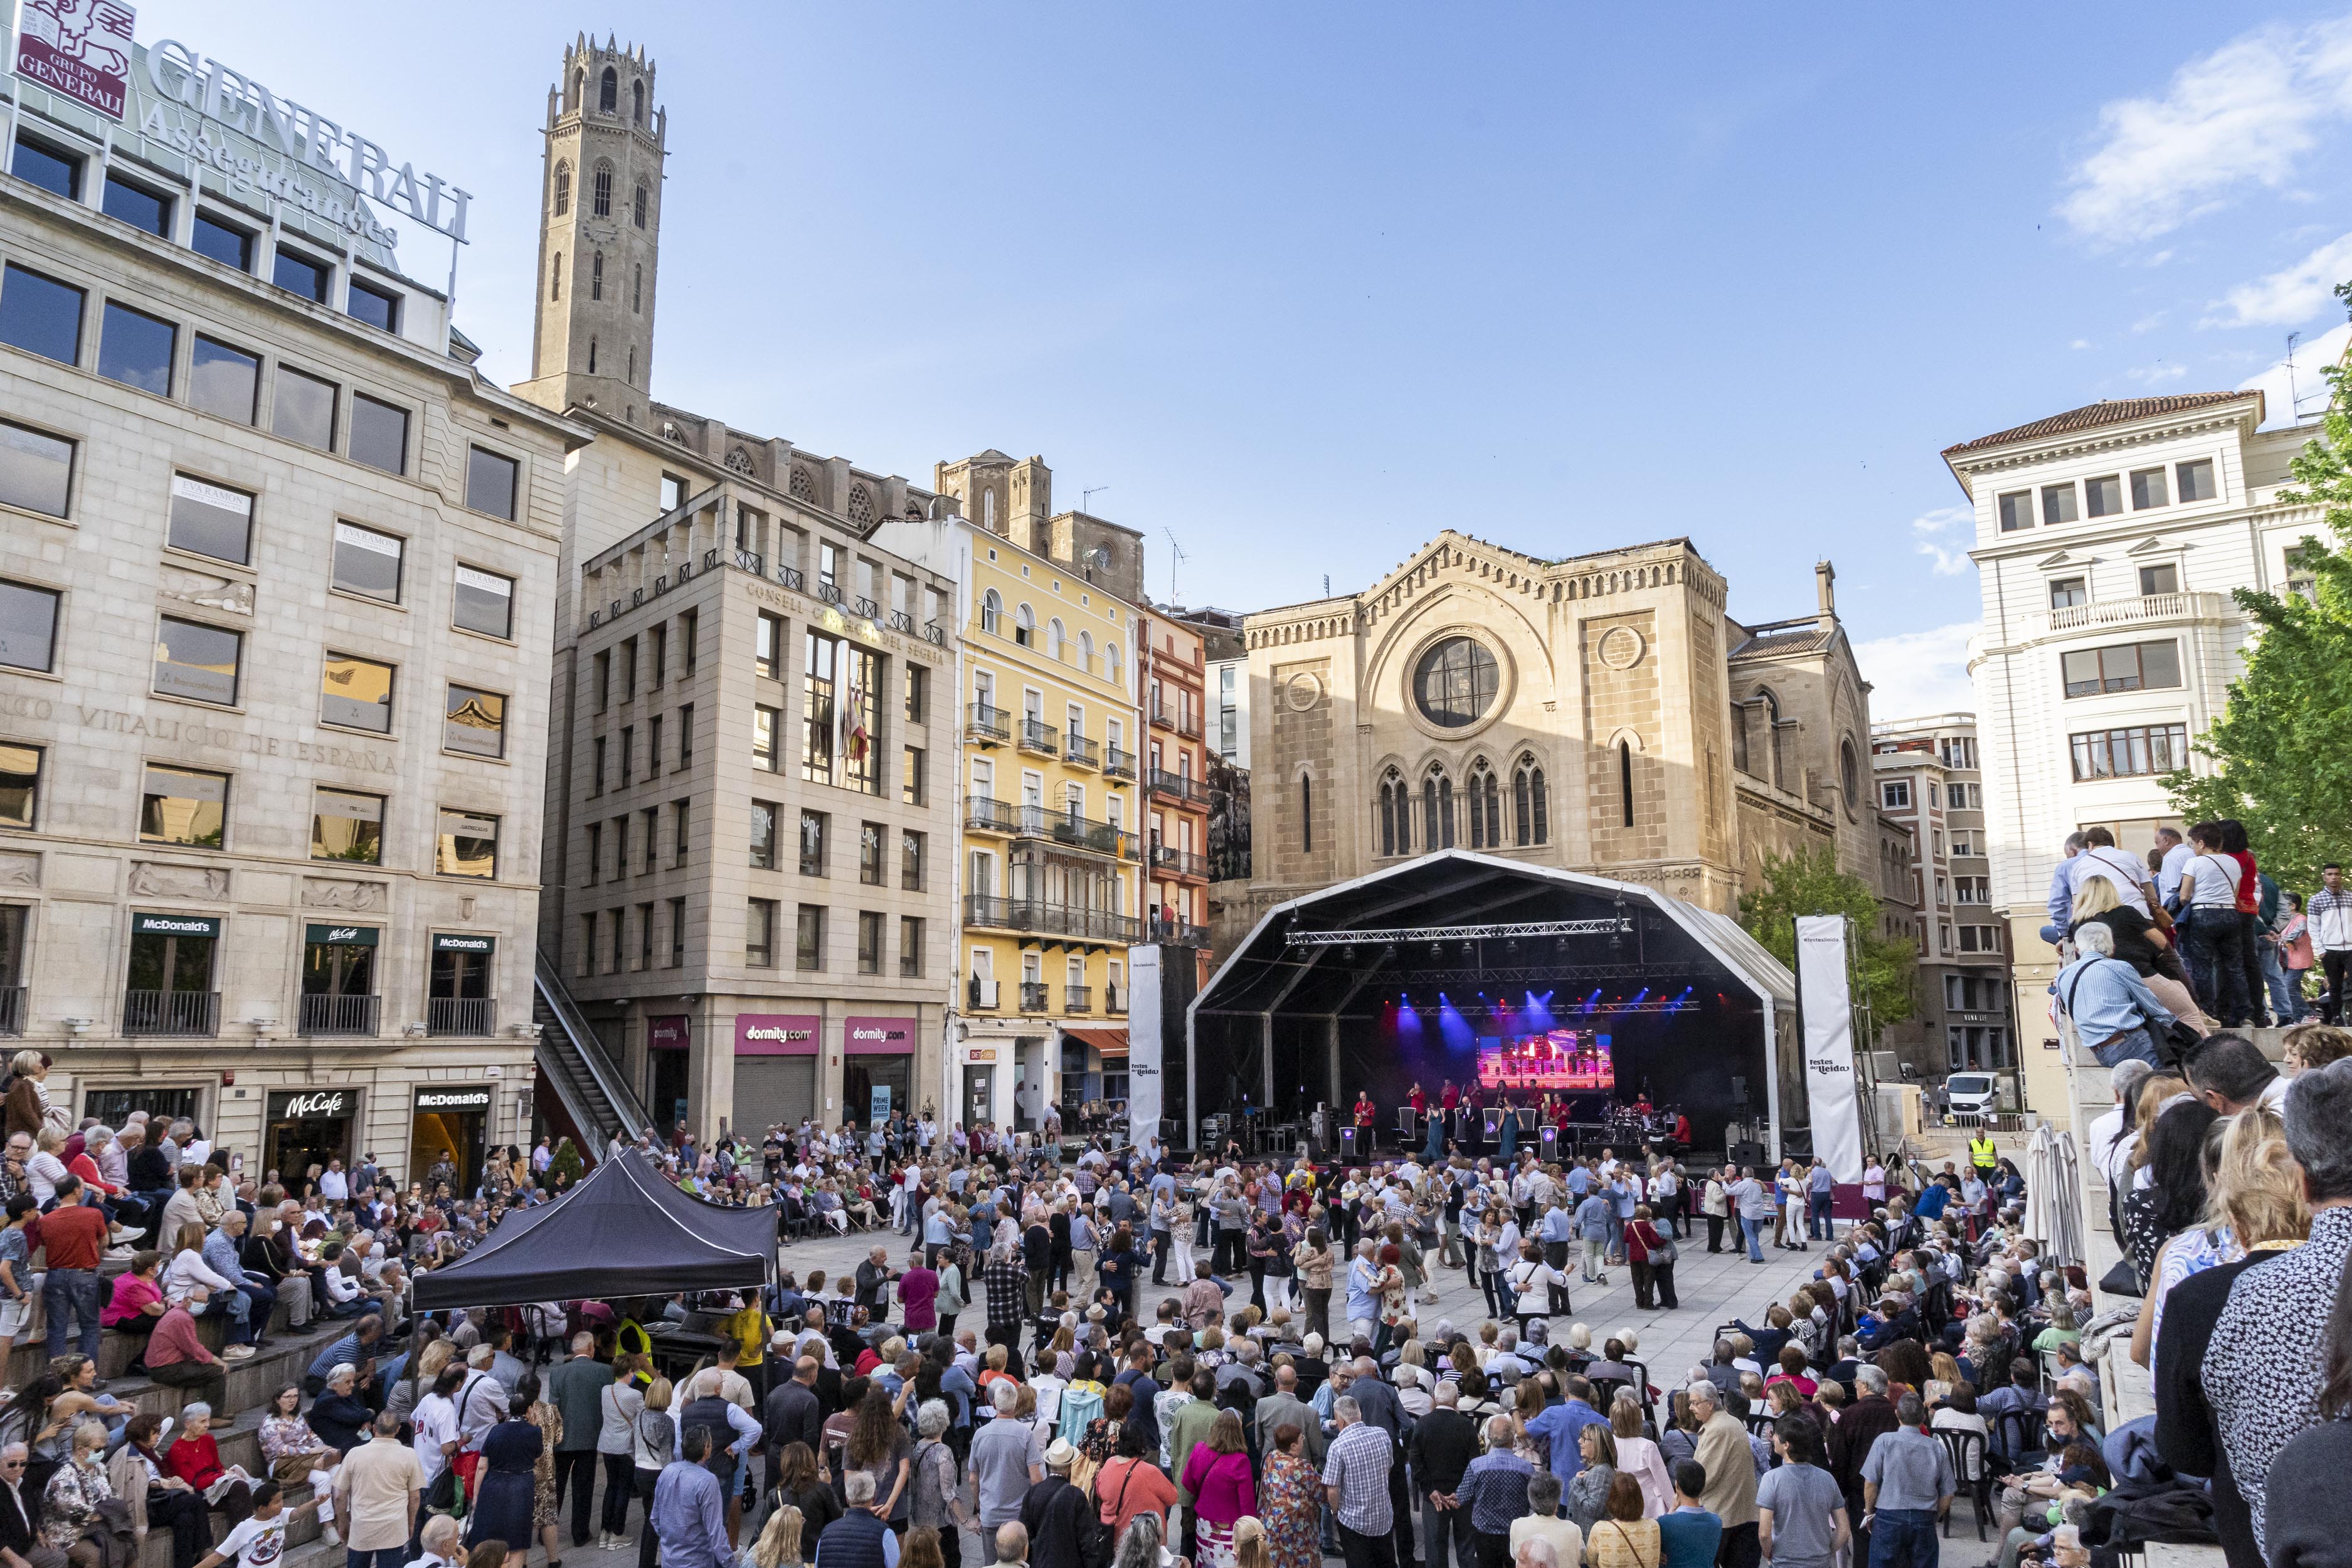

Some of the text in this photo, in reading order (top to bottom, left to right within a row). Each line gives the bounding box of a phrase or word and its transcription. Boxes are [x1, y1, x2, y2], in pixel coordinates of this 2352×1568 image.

[50, 53, 97, 83] GRUPO
[19, 53, 123, 114] GENERALI
[146, 38, 474, 245] GENERALI
[139, 102, 398, 250] Assegurances
[183, 480, 242, 504] EVA RAMON
[343, 527, 394, 548] EVA RAMON
[461, 569, 505, 588] EVA RAMON
[748, 581, 804, 614] CONSELL
[812, 608, 880, 642] COMARCAL
[882, 633, 902, 650] DEL
[77, 705, 231, 748] VITALICIO
[249, 734, 280, 756] DE
[299, 743, 398, 775] ESPAÑA
[142, 918, 210, 932] McDonald's
[440, 938, 487, 949] McDonald's
[746, 1025, 810, 1043] dormity.com
[853, 1027, 905, 1043] dormity.com
[285, 1092, 342, 1118] McCafé
[418, 1093, 489, 1106] McDonald's
